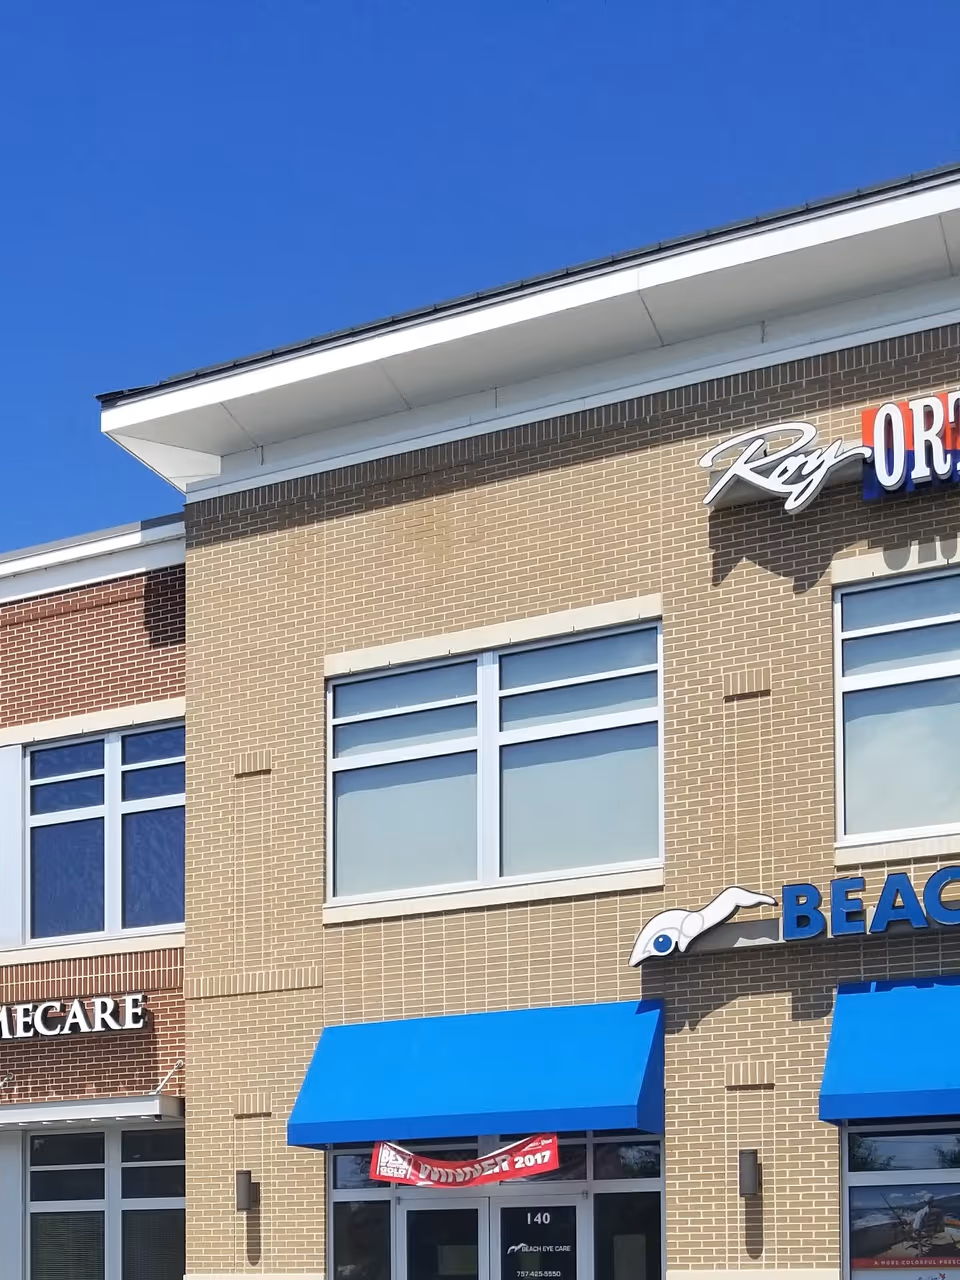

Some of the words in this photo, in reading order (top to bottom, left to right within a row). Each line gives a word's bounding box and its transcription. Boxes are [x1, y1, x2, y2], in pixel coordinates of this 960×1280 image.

[782, 866, 960, 941] BEAC
[380, 1166, 407, 1175] GOLD
[419, 1154, 511, 1183] WINNER
[514, 1150, 551, 1169] 2017
[527, 1212, 551, 1225] 140
